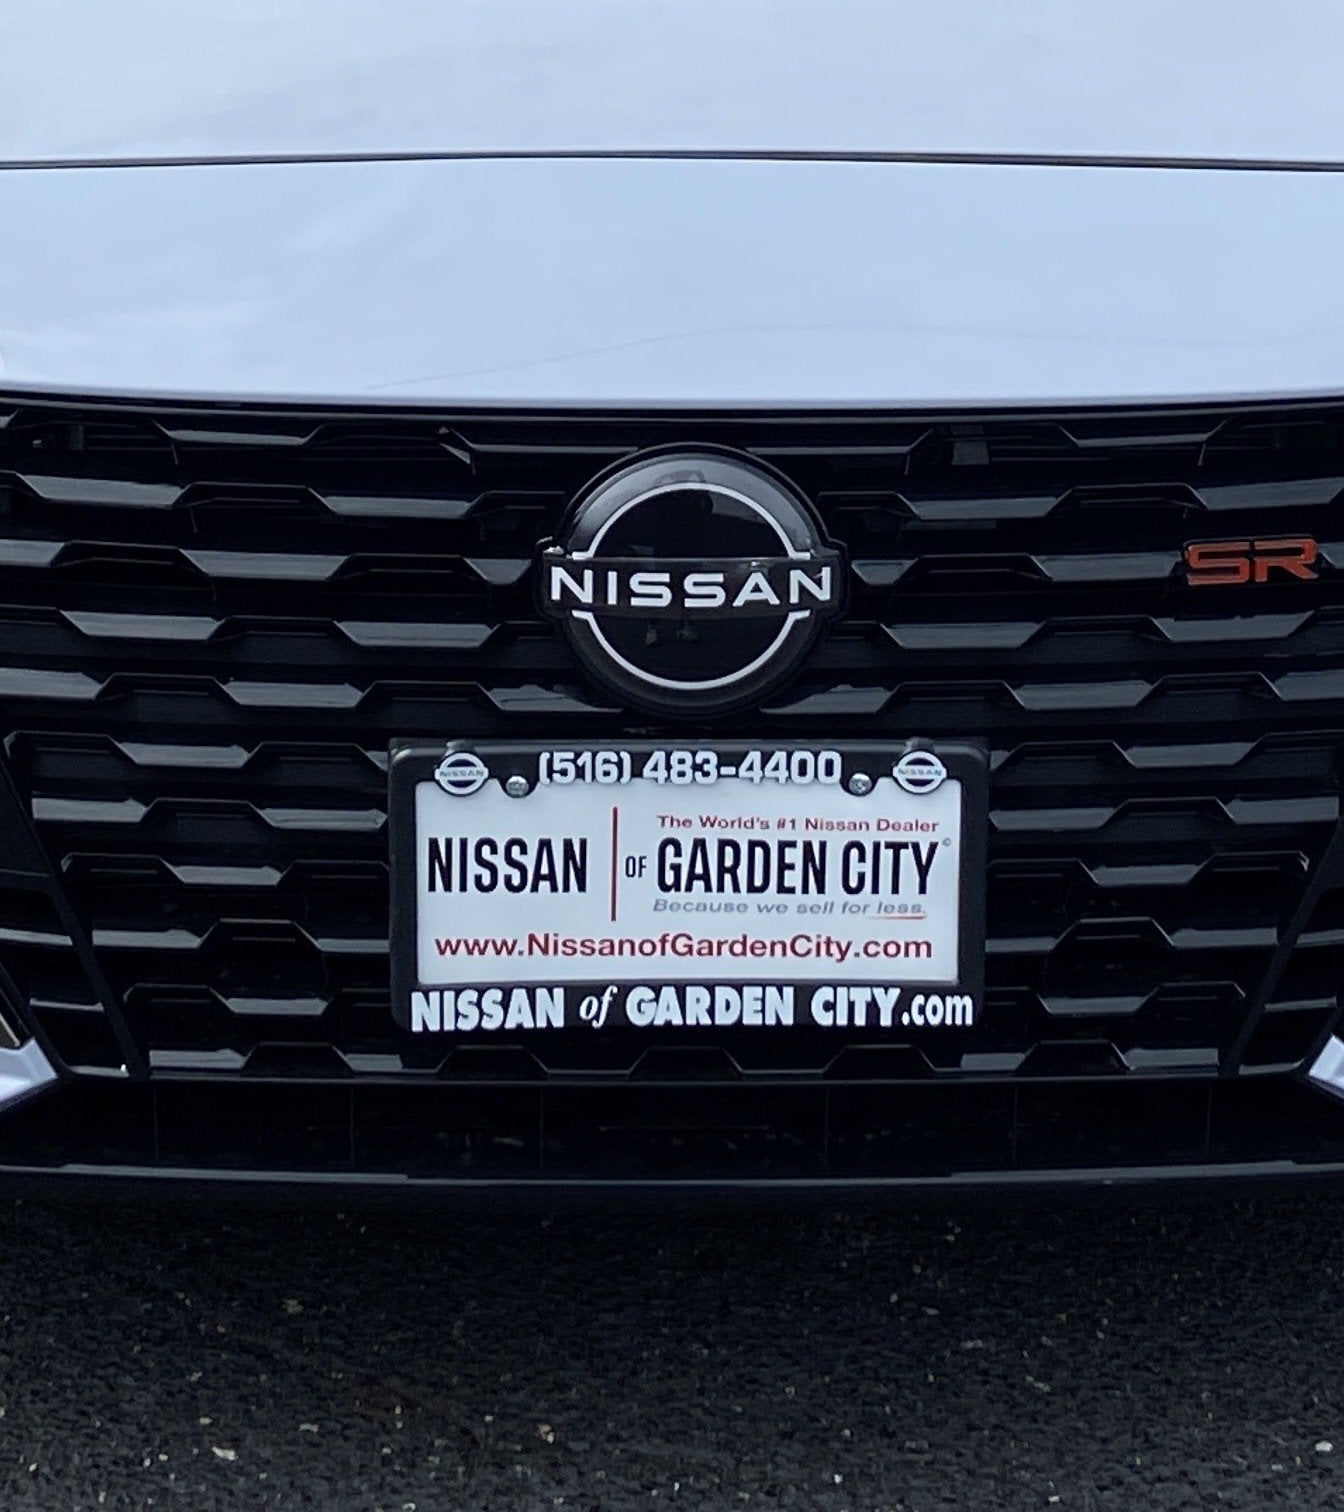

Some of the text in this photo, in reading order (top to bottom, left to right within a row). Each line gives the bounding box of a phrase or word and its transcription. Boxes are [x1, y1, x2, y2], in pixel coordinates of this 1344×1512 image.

[1184, 538, 1320, 587] SR
[550, 566, 831, 608] NISSAN
[438, 768, 485, 779] NISSAN
[538, 749, 843, 786] (516) 483-4400
[897, 767, 943, 778] NISSAN
[657, 814, 940, 833] The World's #1 Nissan Dealer
[427, 836, 940, 896] NISSAN OF GARDEN CITY
[653, 898, 749, 914] Because
[756, 903, 789, 915] we
[796, 900, 834, 915] sell
[841, 900, 871, 915] for
[434, 932, 933, 963] www.NissanofGardenCity.com
[410, 984, 974, 1033] NISSAN of GARDEN CITY.com
